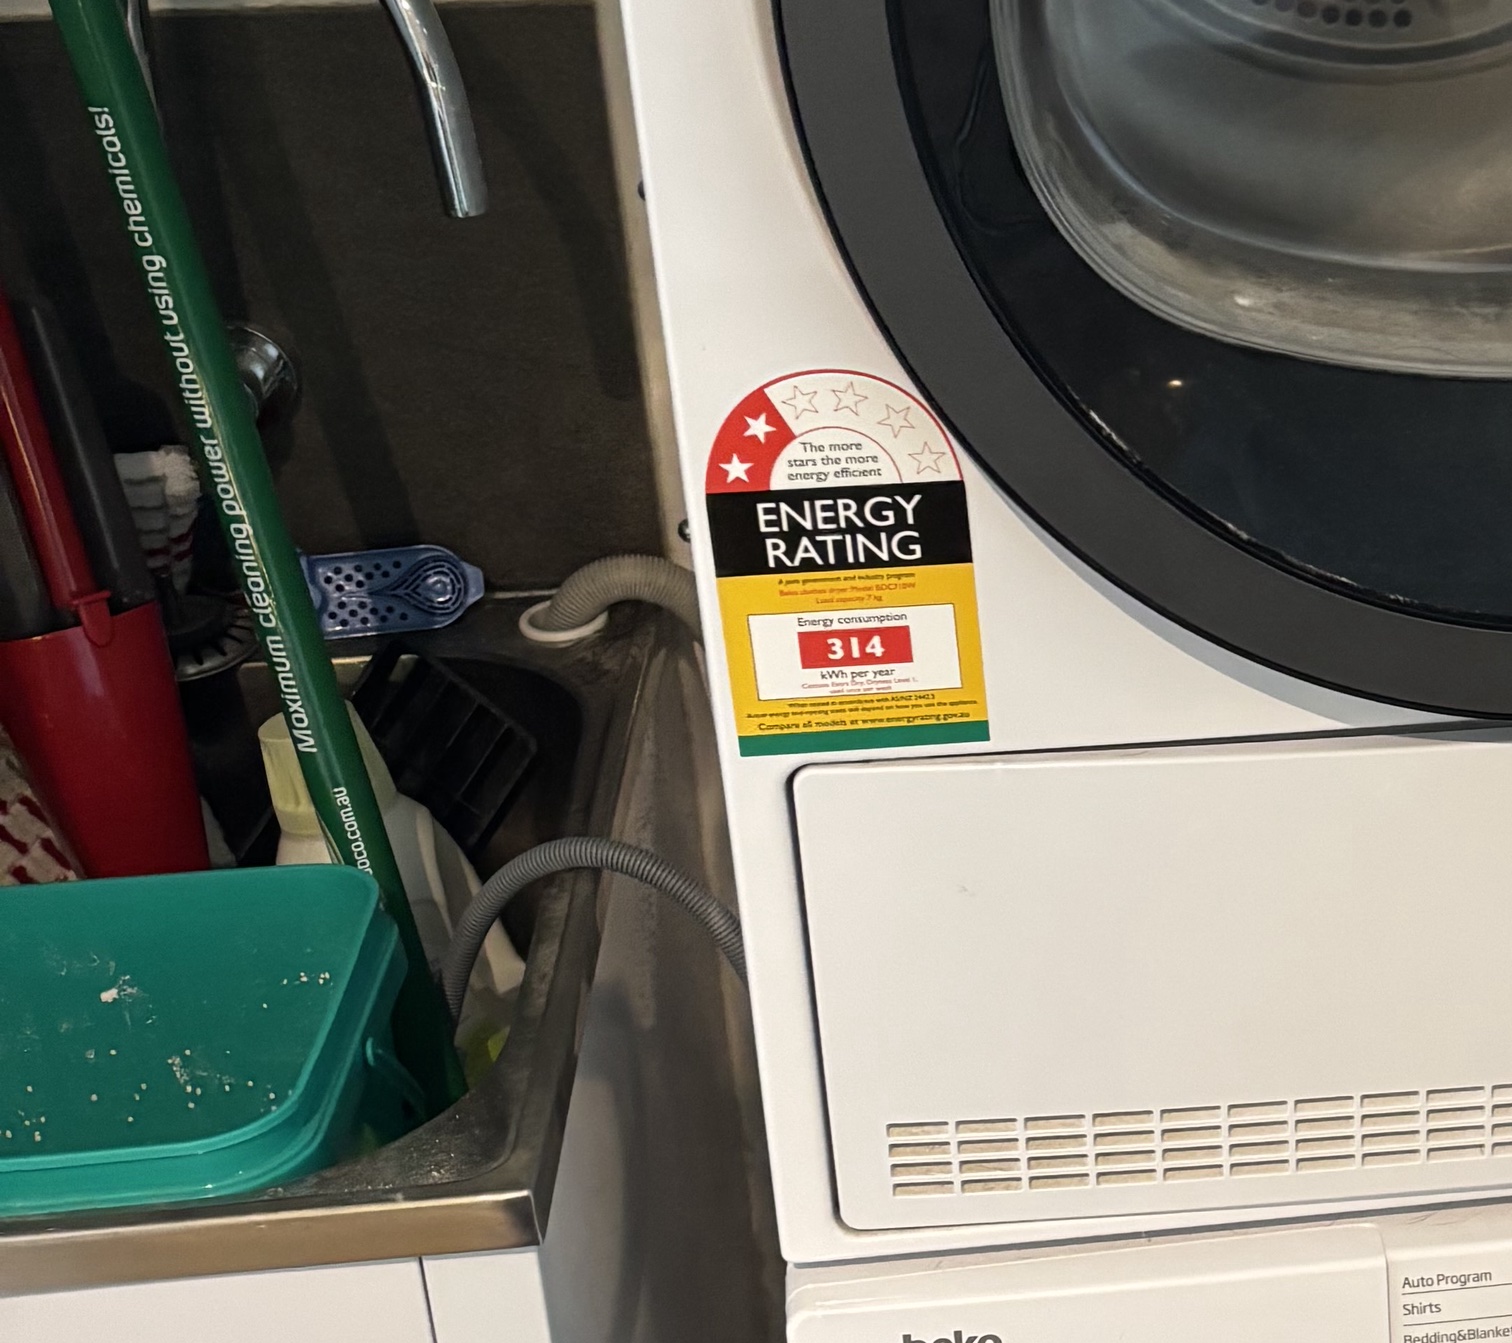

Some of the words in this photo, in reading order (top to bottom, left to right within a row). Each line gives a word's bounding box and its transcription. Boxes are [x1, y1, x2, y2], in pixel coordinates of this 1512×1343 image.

[87, 106, 153, 248] chemicals!
[142, 255, 179, 326] using
[164, 330, 213, 429] without
[787, 458, 817, 467] stars
[821, 456, 841, 465] the
[845, 455, 878, 464] more
[799, 442, 825, 453] The
[829, 442, 862, 451] more
[200, 434, 246, 516] power
[787, 471, 829, 482] energy
[833, 468, 882, 478] efficient
[756, 494, 922, 533] ENERGY
[765, 530, 922, 568] RATING
[229, 523, 276, 628] cleaning
[797, 617, 834, 627] Energy
[837, 612, 907, 624] consumption
[826, 635, 885, 660] 314
[820, 670, 848, 681] kWh
[850, 670, 869, 679] per
[872, 668, 895, 679] year
[266, 636, 317, 753] Maximum
[1402, 1277, 1434, 1289] Auto
[1436, 1271, 1492, 1286] Program
[1402, 1302, 1442, 1316] Shirts
